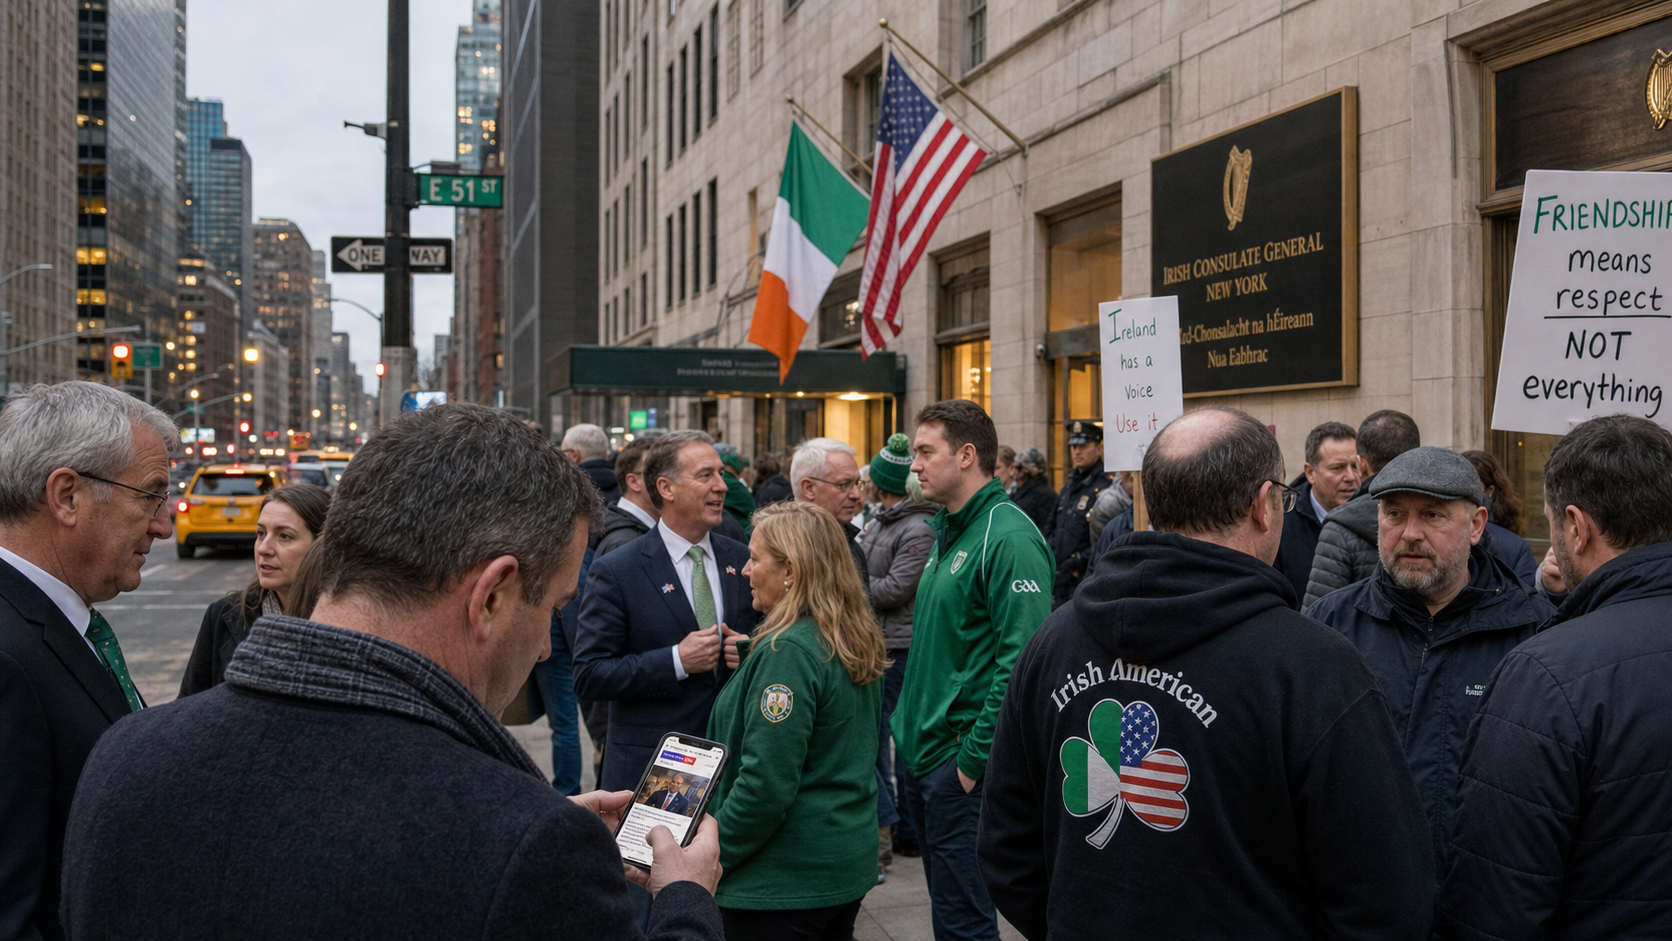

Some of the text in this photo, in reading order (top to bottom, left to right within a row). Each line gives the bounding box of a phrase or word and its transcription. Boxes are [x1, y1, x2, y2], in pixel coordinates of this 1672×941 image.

[429, 178, 498, 203] E 51 ST
[348, 248, 381, 263] ONE
[1163, 232, 1324, 286] IRISH CONSULATE GENERAL
[1568, 250, 1652, 275] means
[1206, 272, 1268, 302] NEW YORK
[1556, 286, 1663, 316] respect
[1108, 308, 1157, 344] Ireland
[1252, 319, 1264, 335] na
[1267, 307, 1314, 332] hÉireann
[1207, 344, 1269, 369] Nua Eabhrac
[1565, 329, 1632, 361] NOT
[1120, 353, 1154, 371] has a
[1522, 373, 1663, 419] everything
[1116, 412, 1158, 434] Use it
[1050, 657, 1218, 729] Irish American
